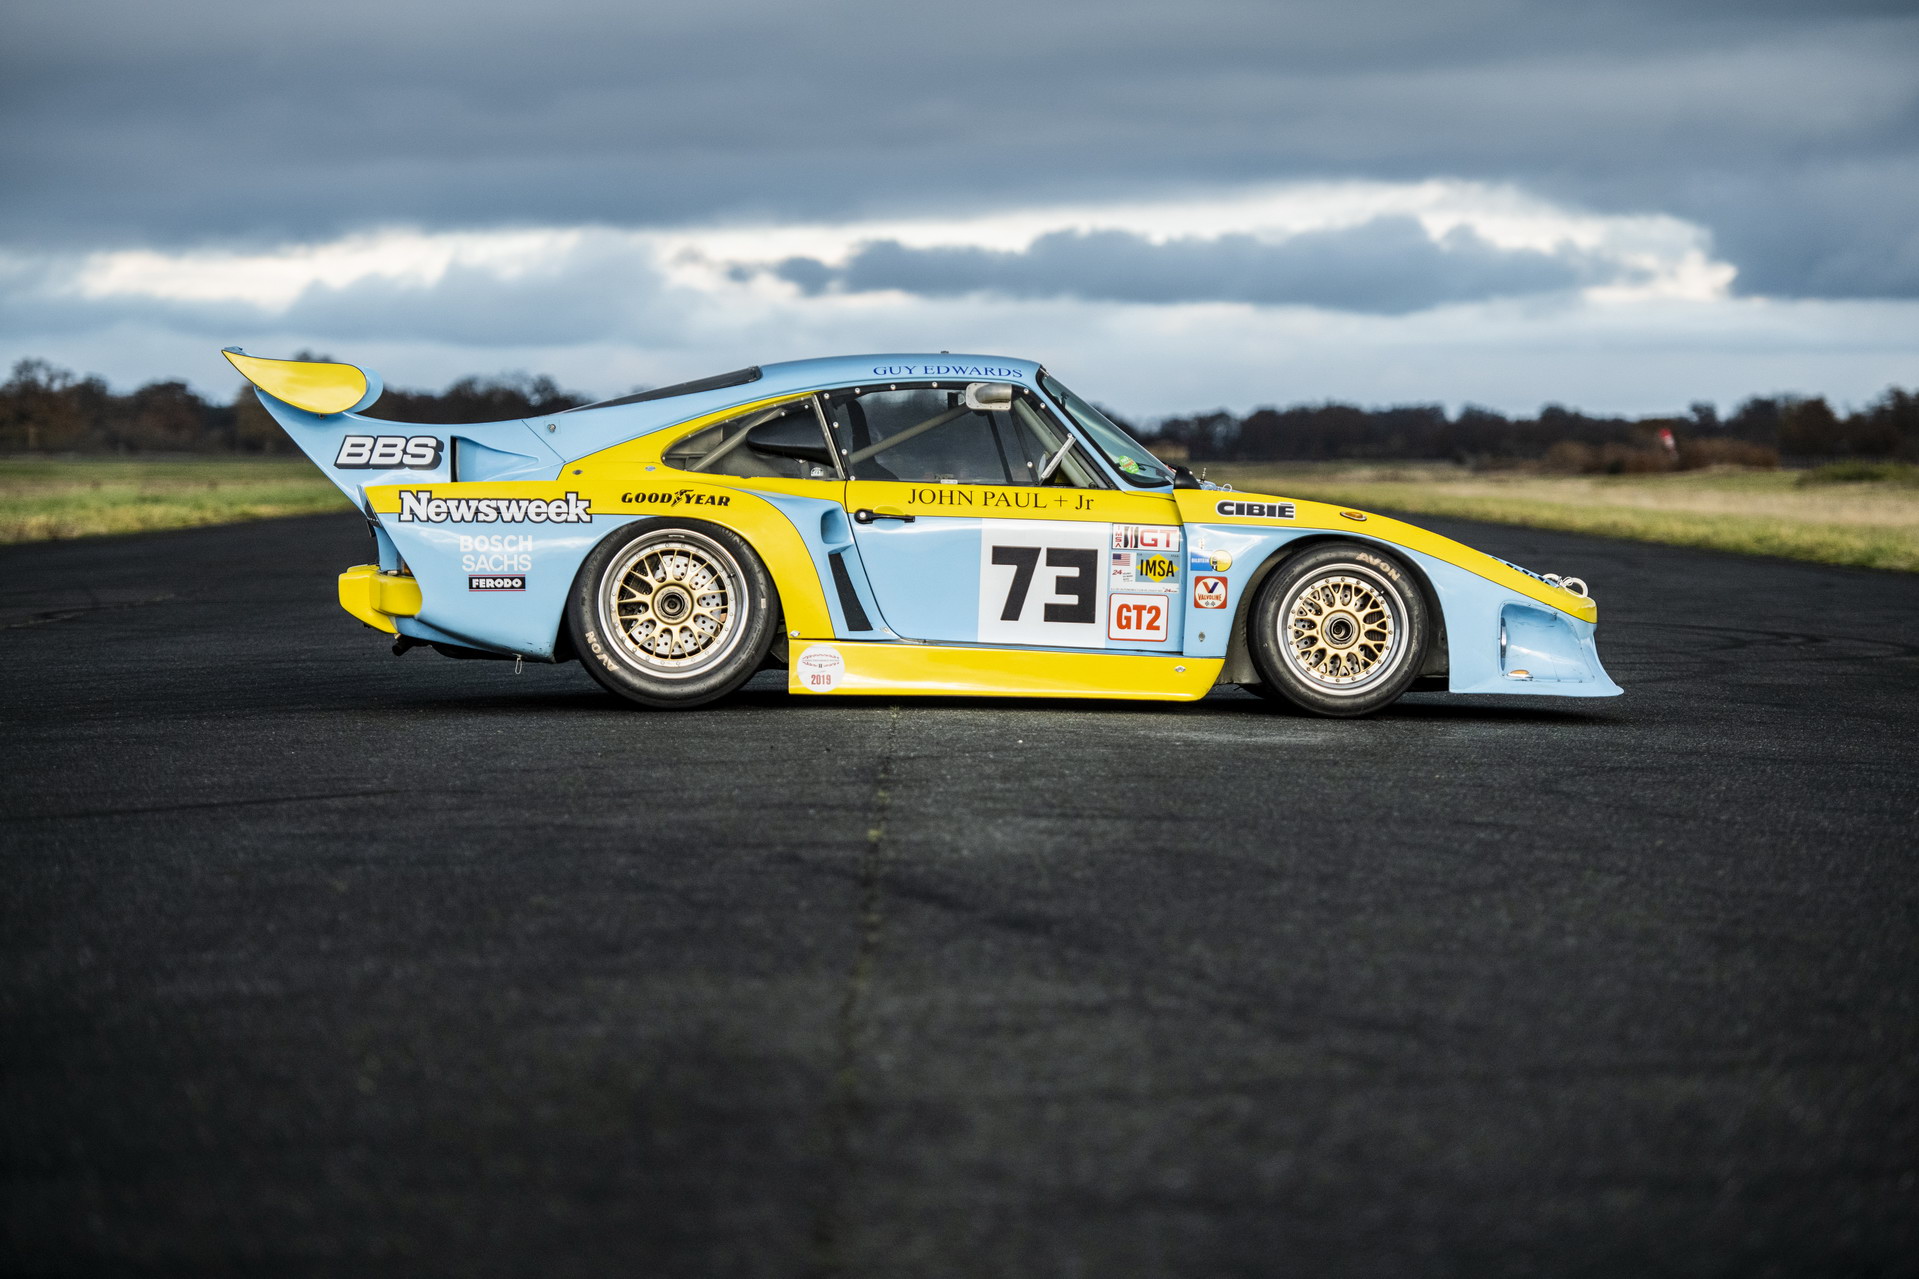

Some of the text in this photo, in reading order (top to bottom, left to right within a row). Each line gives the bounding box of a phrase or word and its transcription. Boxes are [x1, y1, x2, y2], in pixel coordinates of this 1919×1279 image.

[873, 365, 1023, 378] GUY EDWARDS
[334, 434, 444, 470] BBS
[399, 490, 592, 523] Newsweek
[908, 488, 1094, 511] JOHN PAUL + Jr
[460, 535, 533, 552] BOSCH
[1140, 529, 1178, 548] GT
[461, 554, 532, 572] SACHS
[1140, 559, 1175, 577] IMSA
[1356, 552, 1400, 581] AVON
[472, 578, 522, 588] FERODO
[991, 545, 1098, 624] 73
[1198, 593, 1222, 601] VALVOLINE
[1116, 603, 1161, 631] GT2
[585, 631, 620, 671] AVON
[811, 674, 831, 685] 2019
